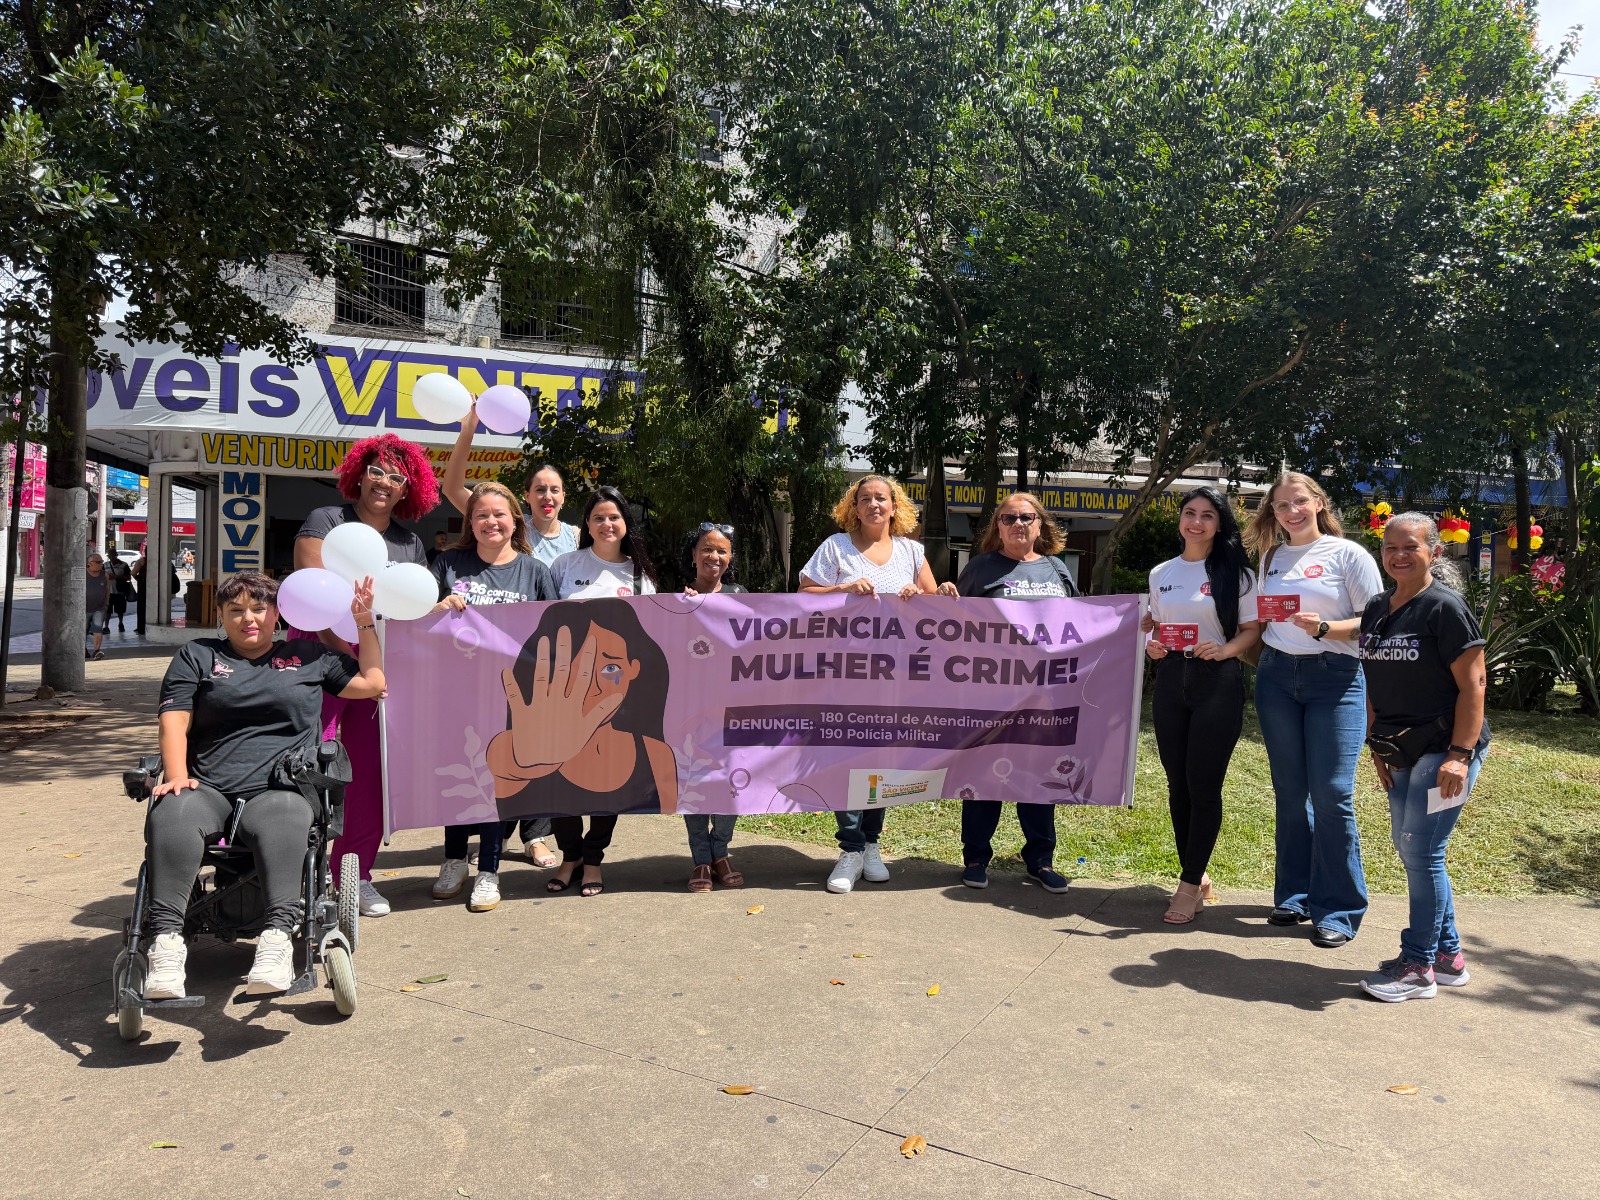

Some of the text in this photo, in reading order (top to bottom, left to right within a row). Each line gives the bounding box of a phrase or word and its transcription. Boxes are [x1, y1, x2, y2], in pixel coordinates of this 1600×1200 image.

[1063, 491, 1077, 508] EM
[1081, 492, 1105, 510] TODA
[1107, 493, 1114, 510] A
[487, 589, 520, 600] CONTRA
[728, 610, 1083, 646] VIOLÊNCIA CONTRA A
[1359, 647, 1419, 661] EMINICÍDIO
[730, 646, 1079, 686] MULHER É CRIME!
[729, 712, 1074, 730] DENUNCIE: 180 Central de Atendimento à Mulher
[820, 728, 941, 742] 190 Polícia Militar
